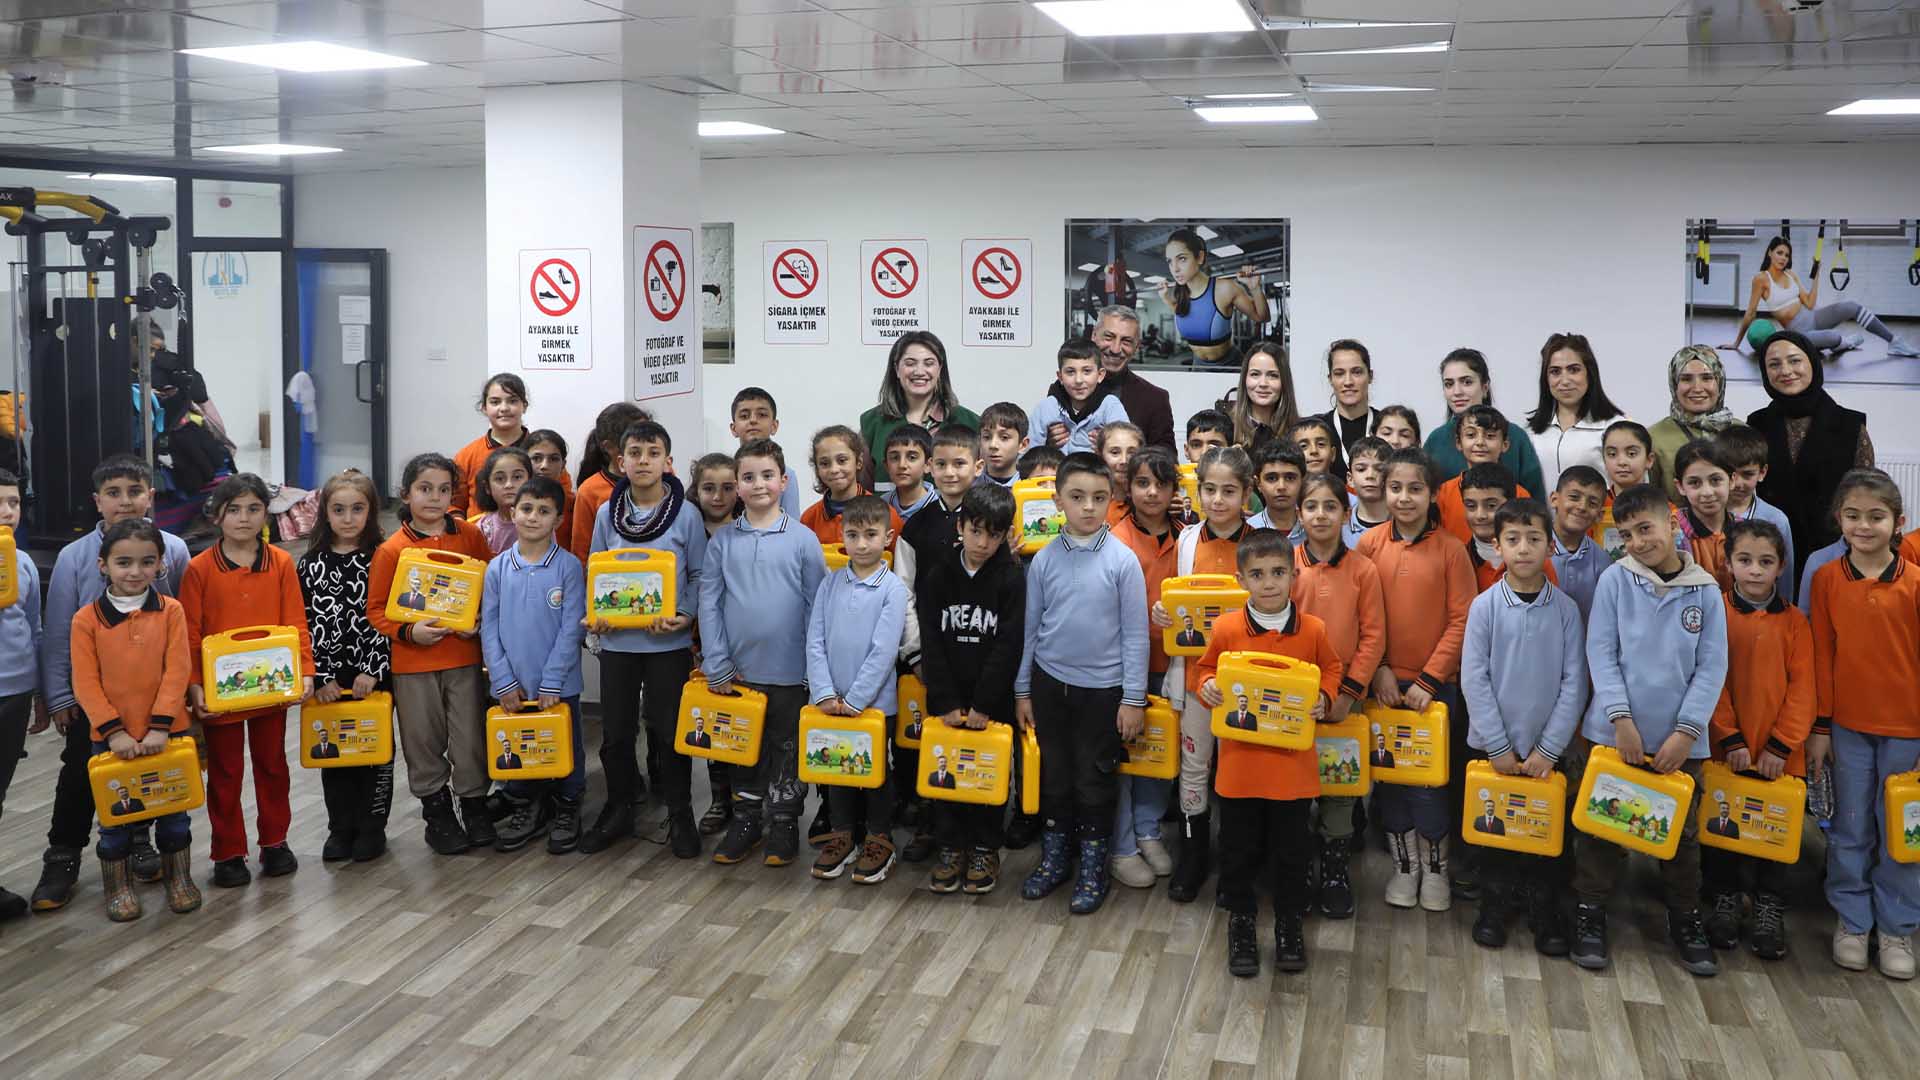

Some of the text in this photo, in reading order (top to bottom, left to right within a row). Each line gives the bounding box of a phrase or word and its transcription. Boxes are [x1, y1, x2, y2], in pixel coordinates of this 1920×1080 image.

[768, 304, 826, 318] SİGARA İÇMEK
[908, 307, 916, 316] VE
[968, 306, 1006, 316] AYAKKABI
[777, 320, 817, 331] YASAKTIR
[892, 318, 919, 328] ÇEKMEK
[528, 325, 565, 335] AYAKKABI
[978, 331, 1015, 341] YASAKTIR
[645, 333, 684, 350] FOTOĞRAF VE
[537, 353, 575, 363] YASAKTIR
[643, 352, 686, 370] VİDEO ÇEKMEK
[650, 371, 679, 385] YASAKTIR
